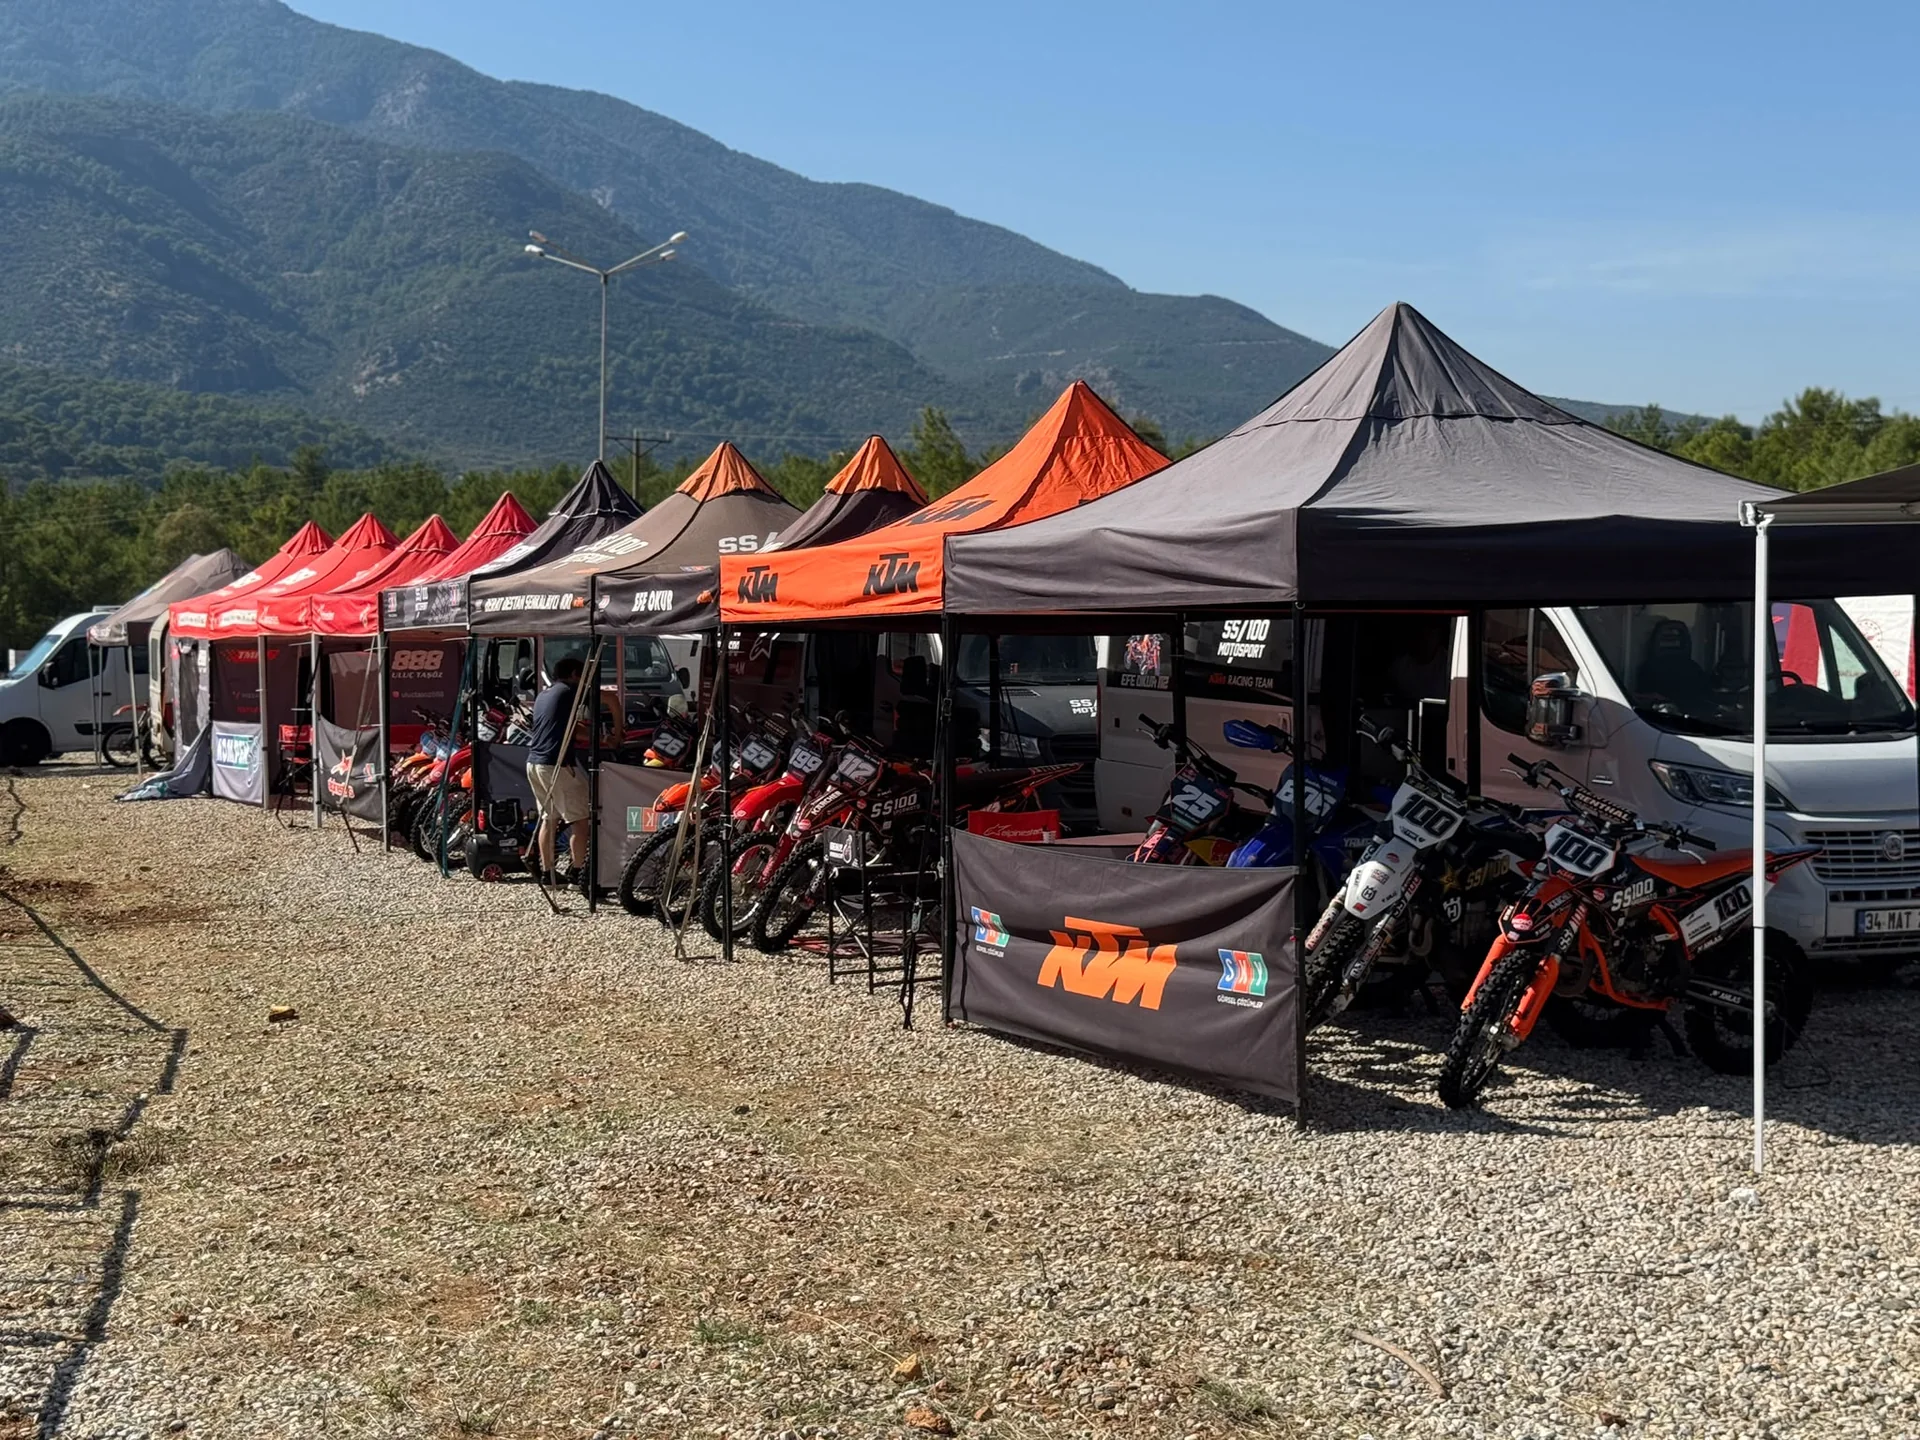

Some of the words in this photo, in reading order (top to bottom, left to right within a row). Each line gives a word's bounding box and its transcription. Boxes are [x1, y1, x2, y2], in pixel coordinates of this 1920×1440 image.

[738, 565, 779, 604] KTM
[863, 552, 921, 596] KTM
[632, 591, 648, 611] EFE
[648, 590, 673, 611] OKUR
[391, 650, 444, 670] 888
[1217, 642, 1266, 659] MOTOSPORT
[1120, 673, 1137, 687] EFE
[1227, 675, 1254, 687] RACING
[1255, 677, 1274, 688] TEAM
[652, 732, 686, 757] 26
[789, 746, 823, 774] 199
[839, 753, 877, 785] 112
[871, 793, 918, 819] SS100
[1171, 783, 1221, 820] 25
[1396, 792, 1457, 837] 100
[1574, 791, 1630, 821] RENTHAL
[1548, 831, 1609, 873] 100
[1610, 878, 1654, 912] SS100
[1714, 884, 1750, 922] 100
[1866, 912, 1881, 930] 34
[1888, 911, 1912, 930] MAT
[1037, 916, 1178, 1011] KTM
